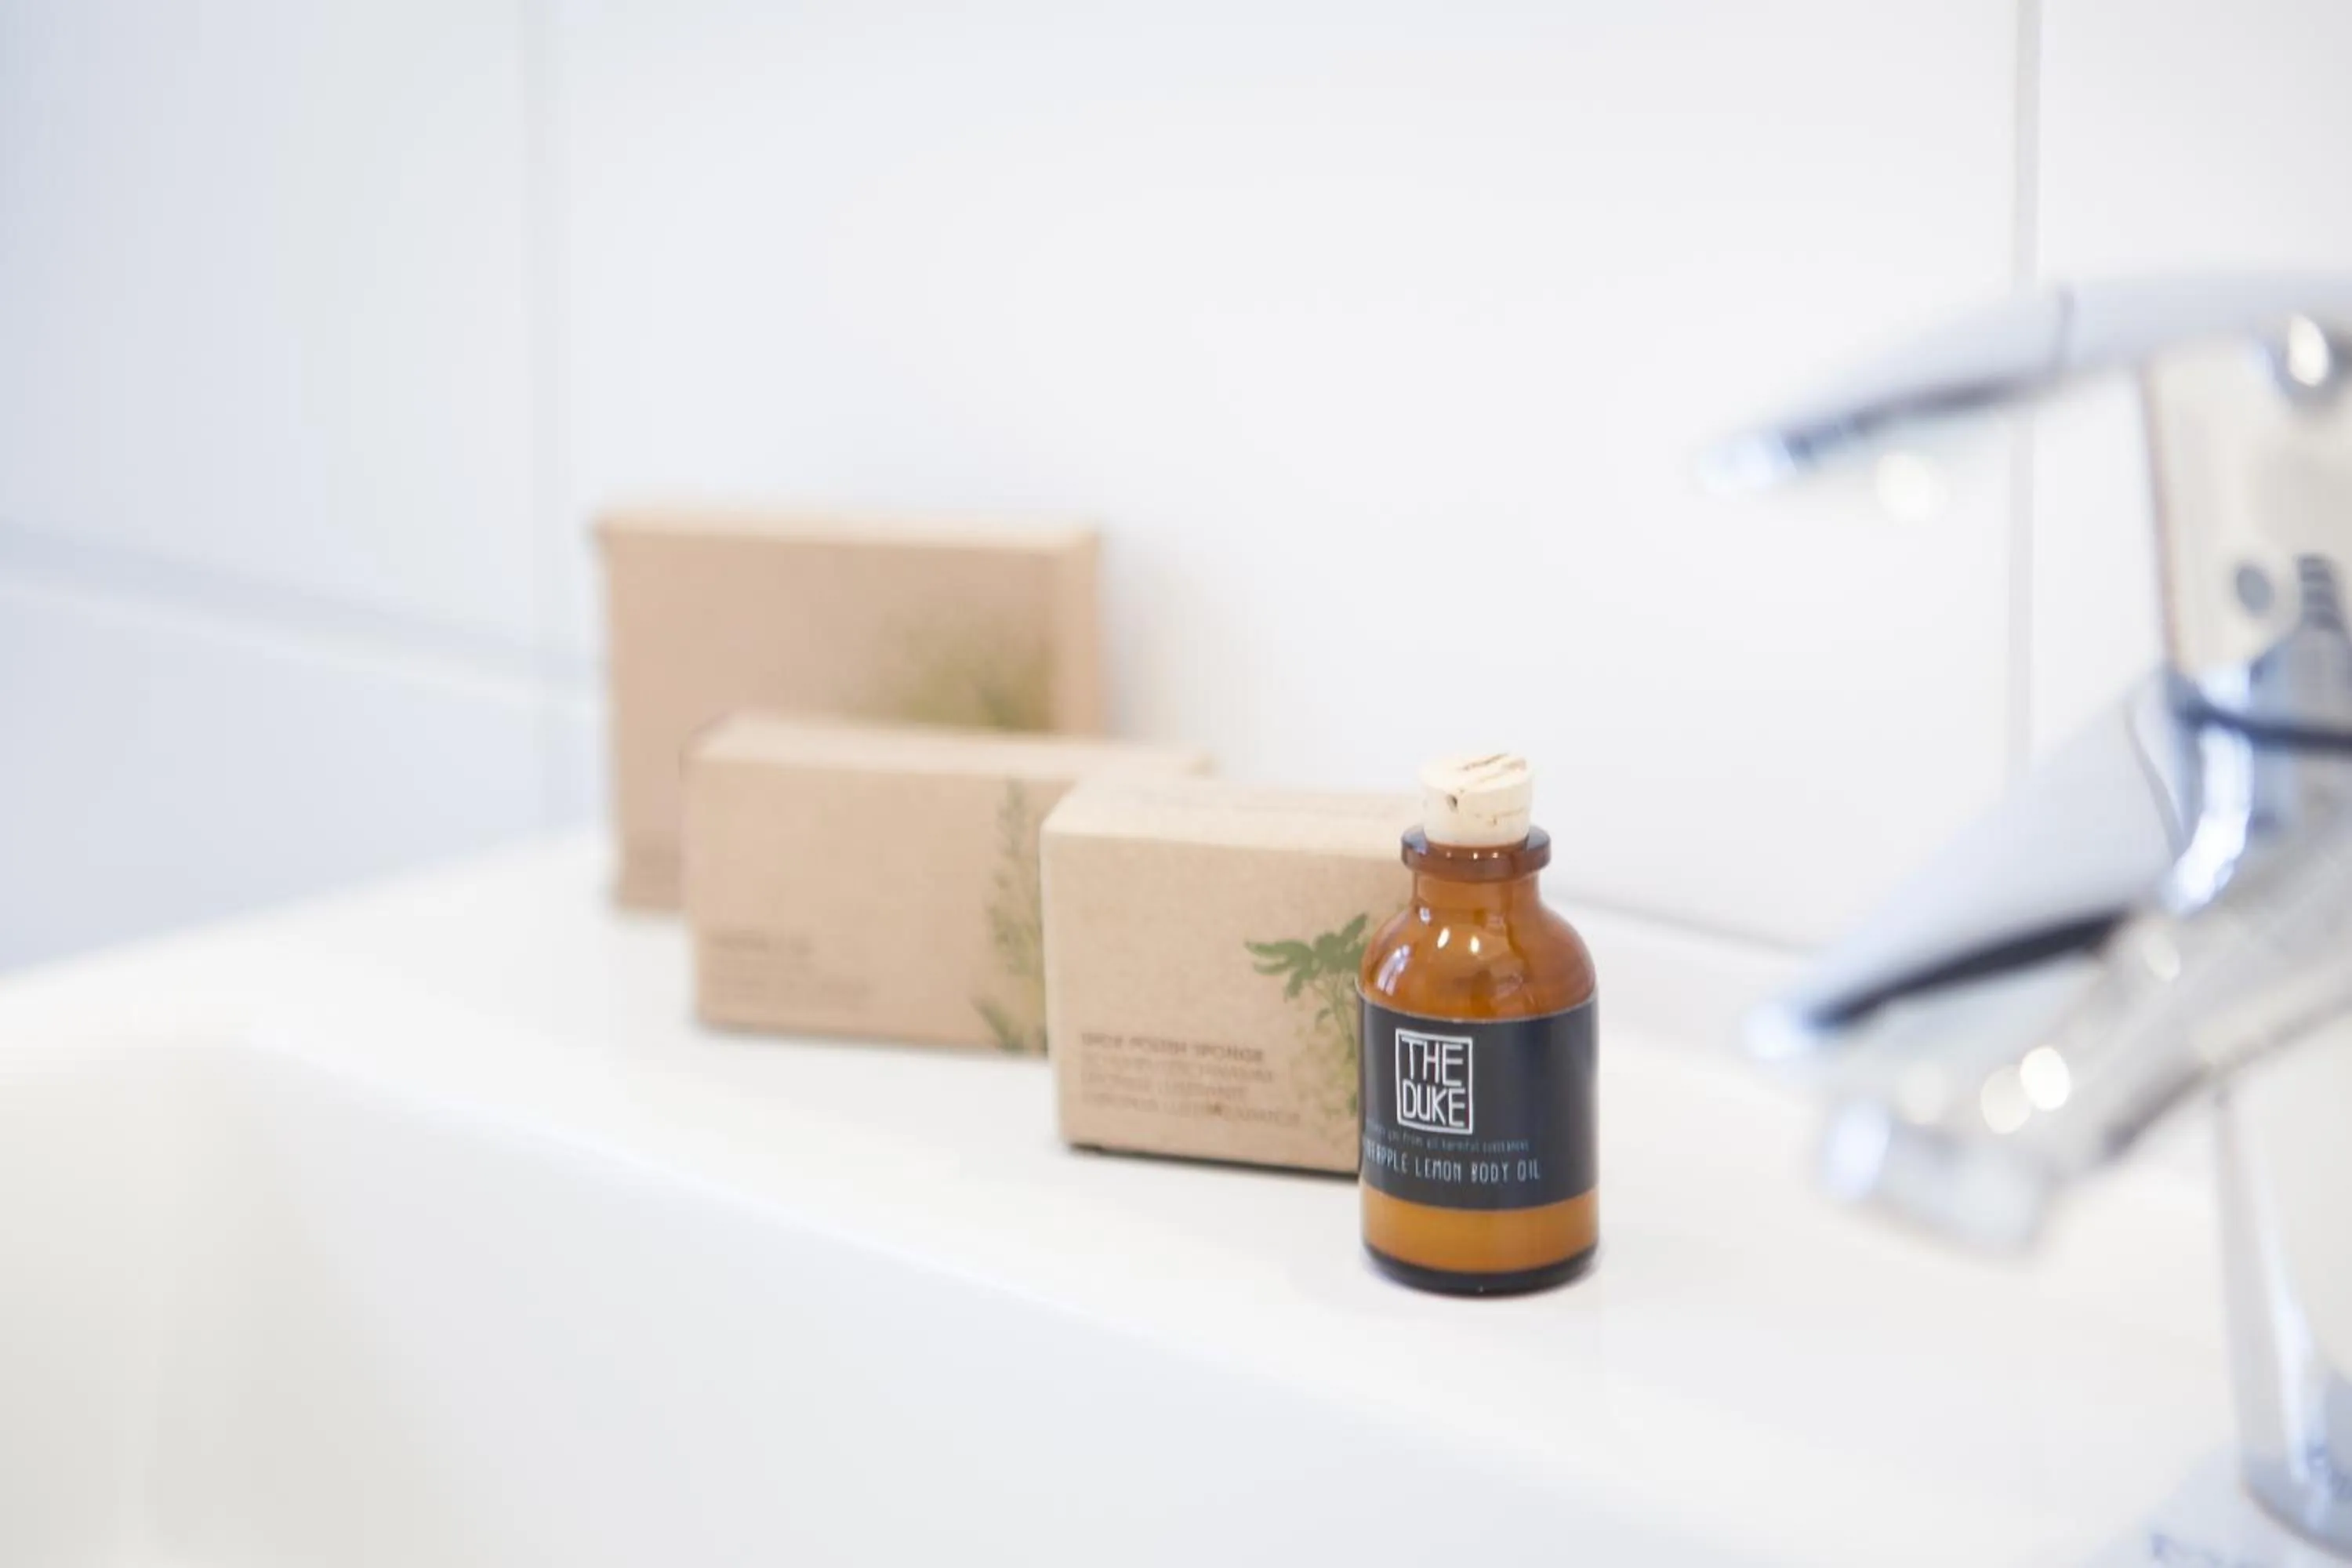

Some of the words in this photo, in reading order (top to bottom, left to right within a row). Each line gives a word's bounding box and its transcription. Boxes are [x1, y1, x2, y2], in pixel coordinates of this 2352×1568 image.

[1401, 1036, 1463, 1087] THE
[1403, 1079, 1465, 1127] DUKE
[1415, 1156, 1461, 1184] LEMON
[1471, 1161, 1509, 1185] BODY
[1517, 1159, 1541, 1182] OIL
